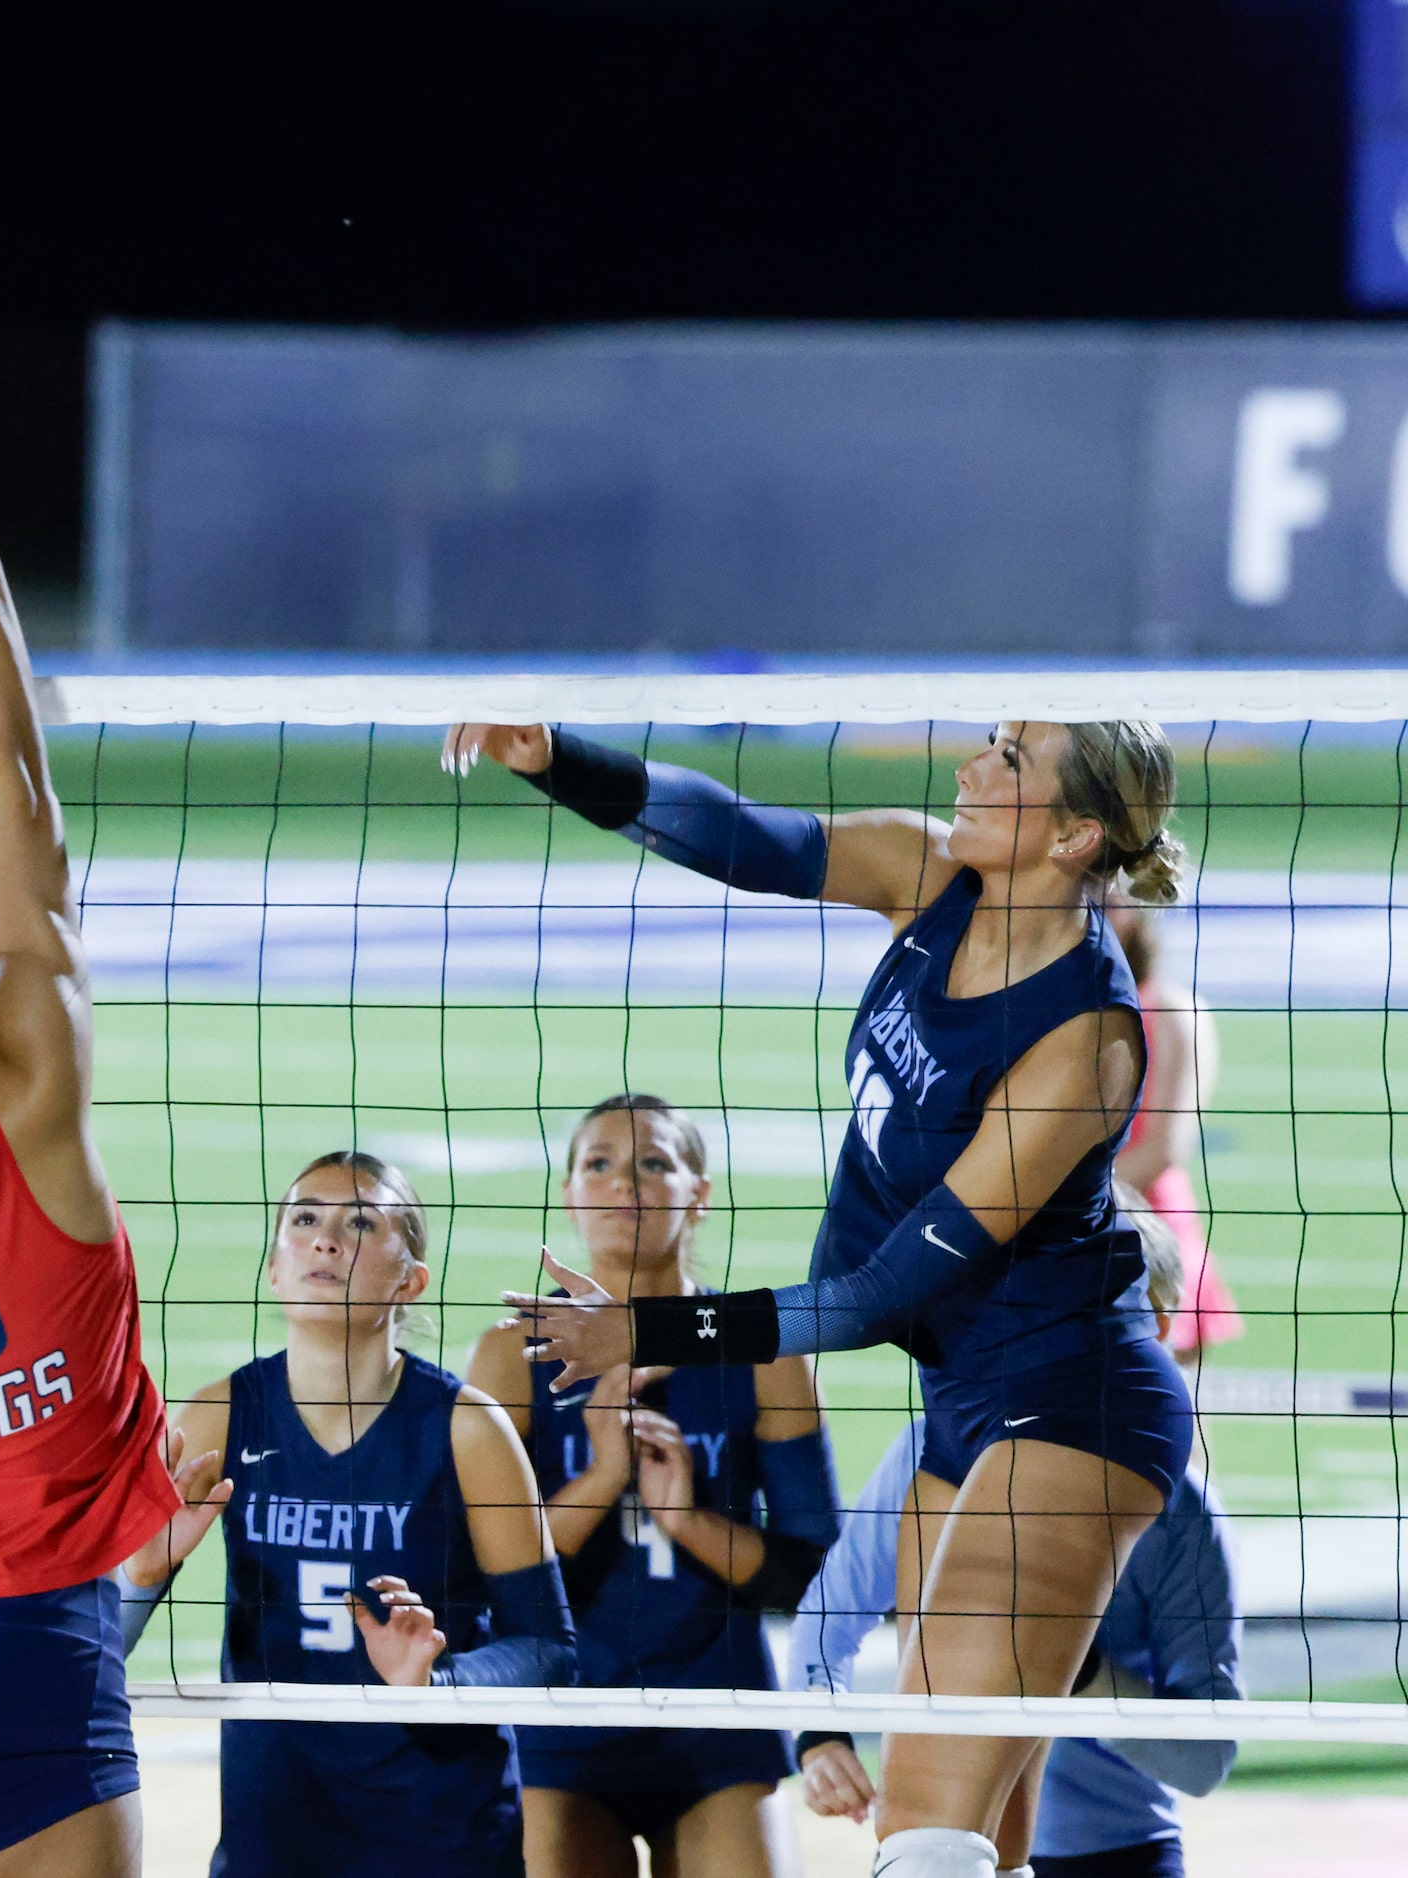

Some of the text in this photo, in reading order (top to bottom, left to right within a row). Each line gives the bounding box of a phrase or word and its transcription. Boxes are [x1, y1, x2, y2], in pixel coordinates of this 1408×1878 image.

[1226, 388, 1408, 606] F
[245, 1491, 413, 1551] LIBERTY
[297, 1559, 356, 1652] 5
